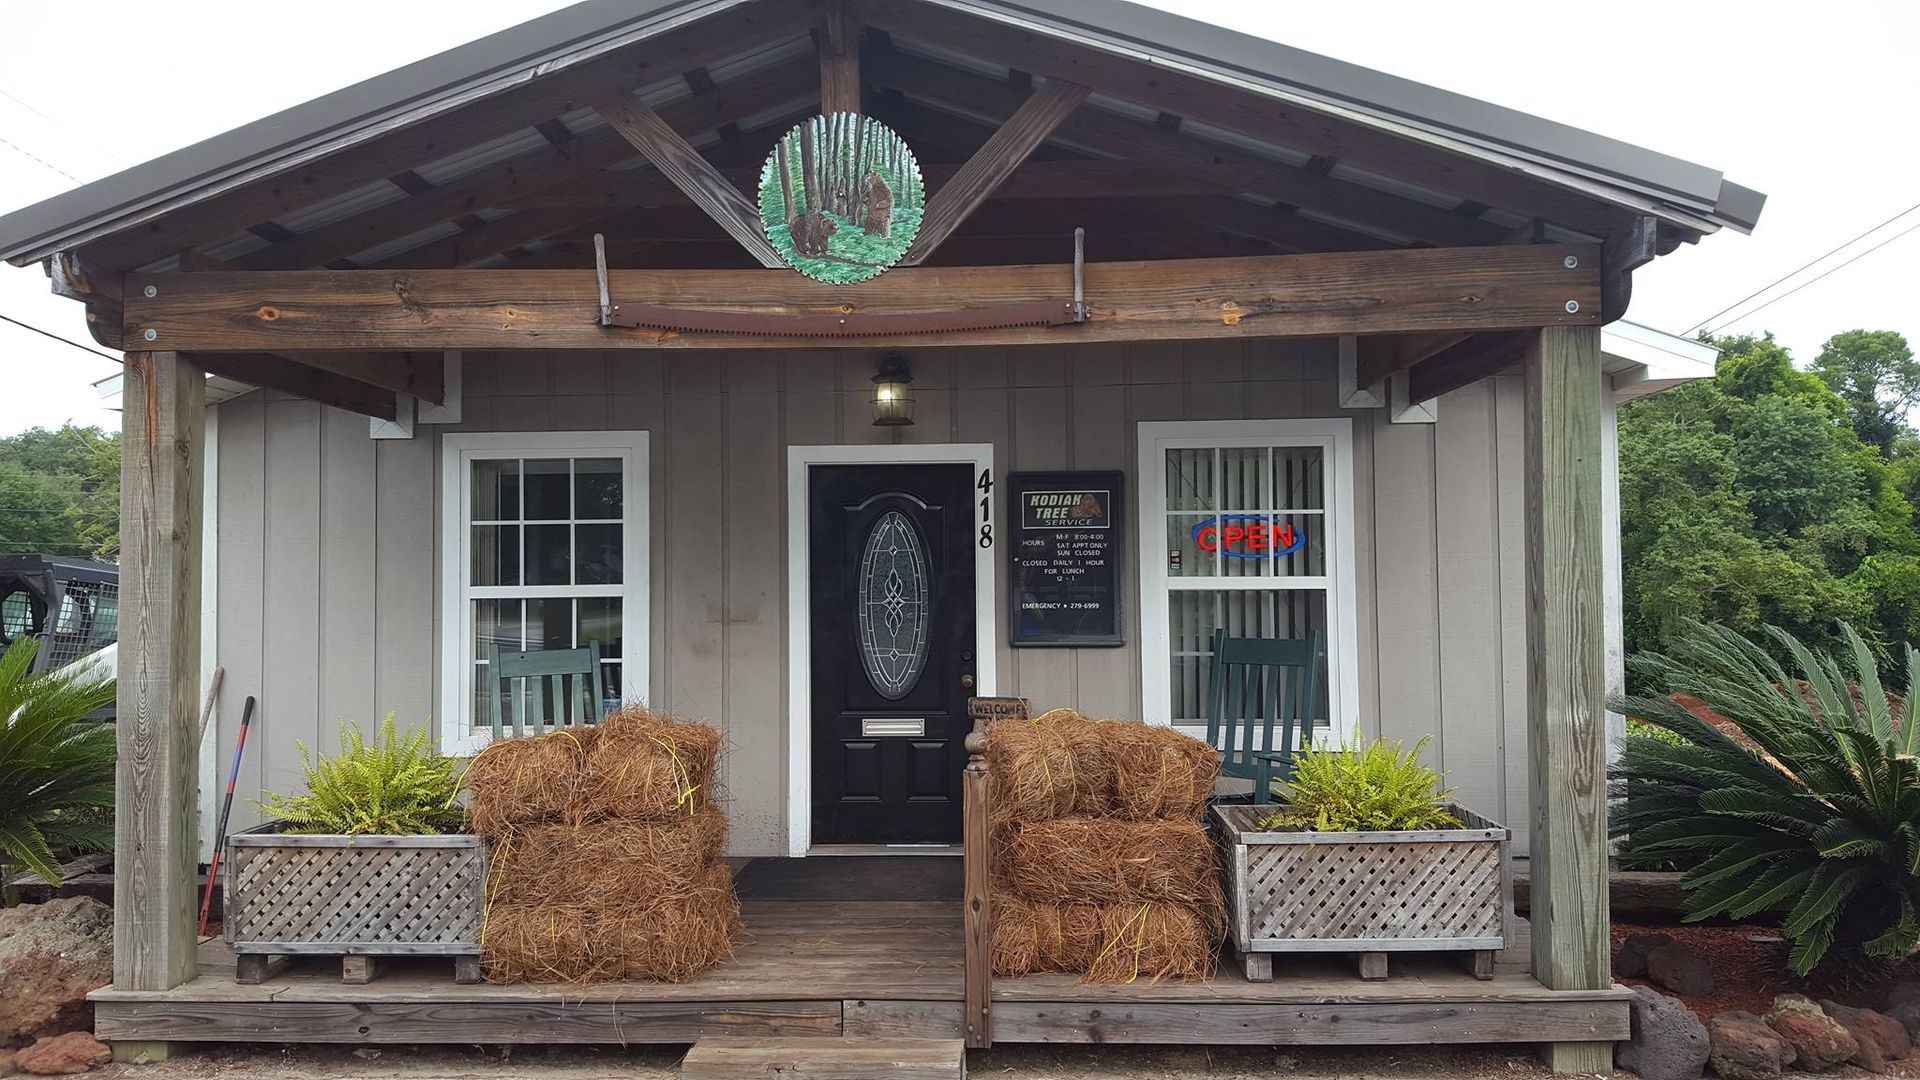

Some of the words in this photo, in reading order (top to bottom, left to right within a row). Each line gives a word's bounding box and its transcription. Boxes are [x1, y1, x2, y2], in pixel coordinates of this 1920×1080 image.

[1030, 494, 1082, 506] KODIAK
[977, 468, 993, 548] 418
[1036, 507, 1069, 519] TREE
[1197, 524, 1294, 551] OPEN
[974, 703, 1022, 714] WELCOME
